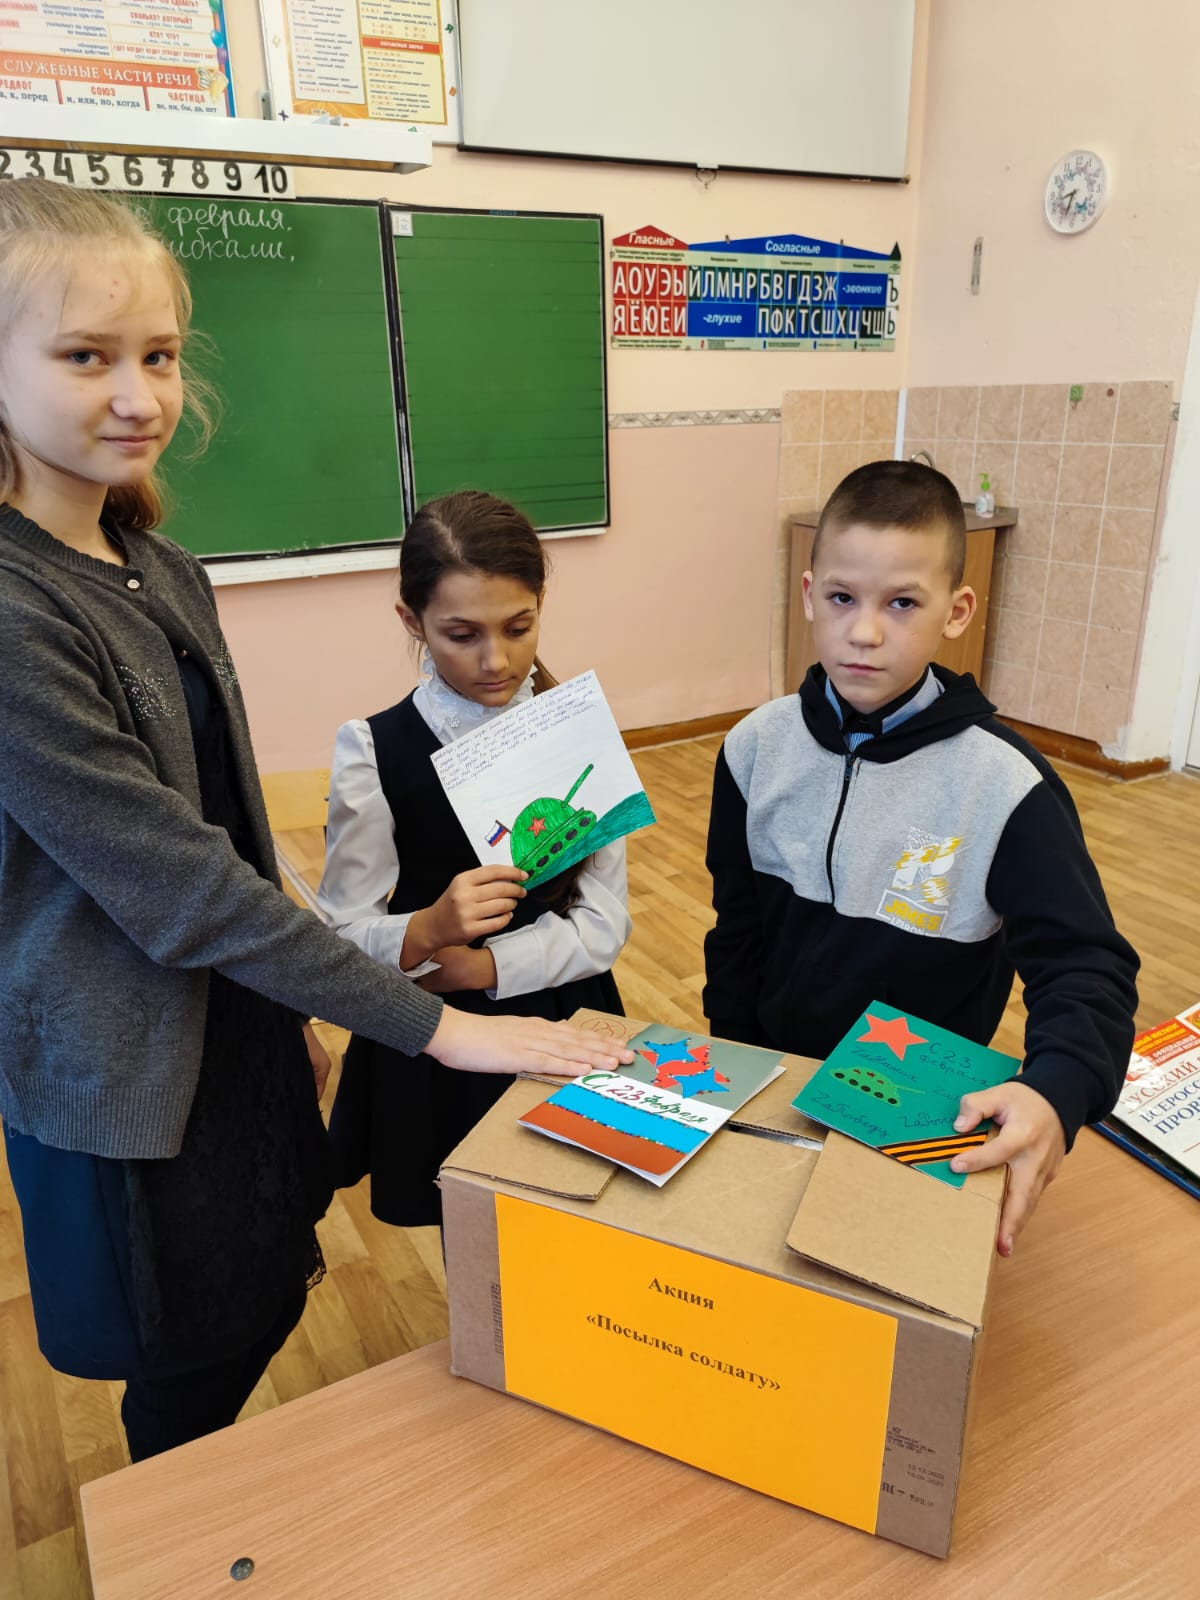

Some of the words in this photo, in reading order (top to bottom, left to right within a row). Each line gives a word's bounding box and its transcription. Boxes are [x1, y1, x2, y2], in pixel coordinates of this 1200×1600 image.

[3, 59, 101, 79] СЛУЖЕБНЫЕ
[103, 68, 153, 84] ЧАСТИ
[156, 72, 193, 87] РЕЧИ
[21, 92, 49, 102] перед
[90, 86, 116, 97] СОЮЗ
[168, 91, 206, 104] ЧАСТИЦА
[116, 99, 140, 108] когда
[25, 151, 45, 180] 3
[53, 153, 75, 183] 4
[87, 153, 110, 186] 5
[123, 156, 144, 187] 6
[157, 158, 174, 189] 7
[191, 160, 209, 190] 8
[223, 162, 242, 192] 9
[254, 164, 288, 194] 10
[168, 203, 292, 239] февраля.
[629, 232, 676, 247] Гласные
[765, 240, 821, 255] Согласные
[944, 1049, 972, 1069] 23
[606, 1084, 646, 1101] 23
[648, 1277, 715, 1310] Акция
[586, 1313, 684, 1358] «Посылка
[690, 1350, 781, 1391] солдату»
